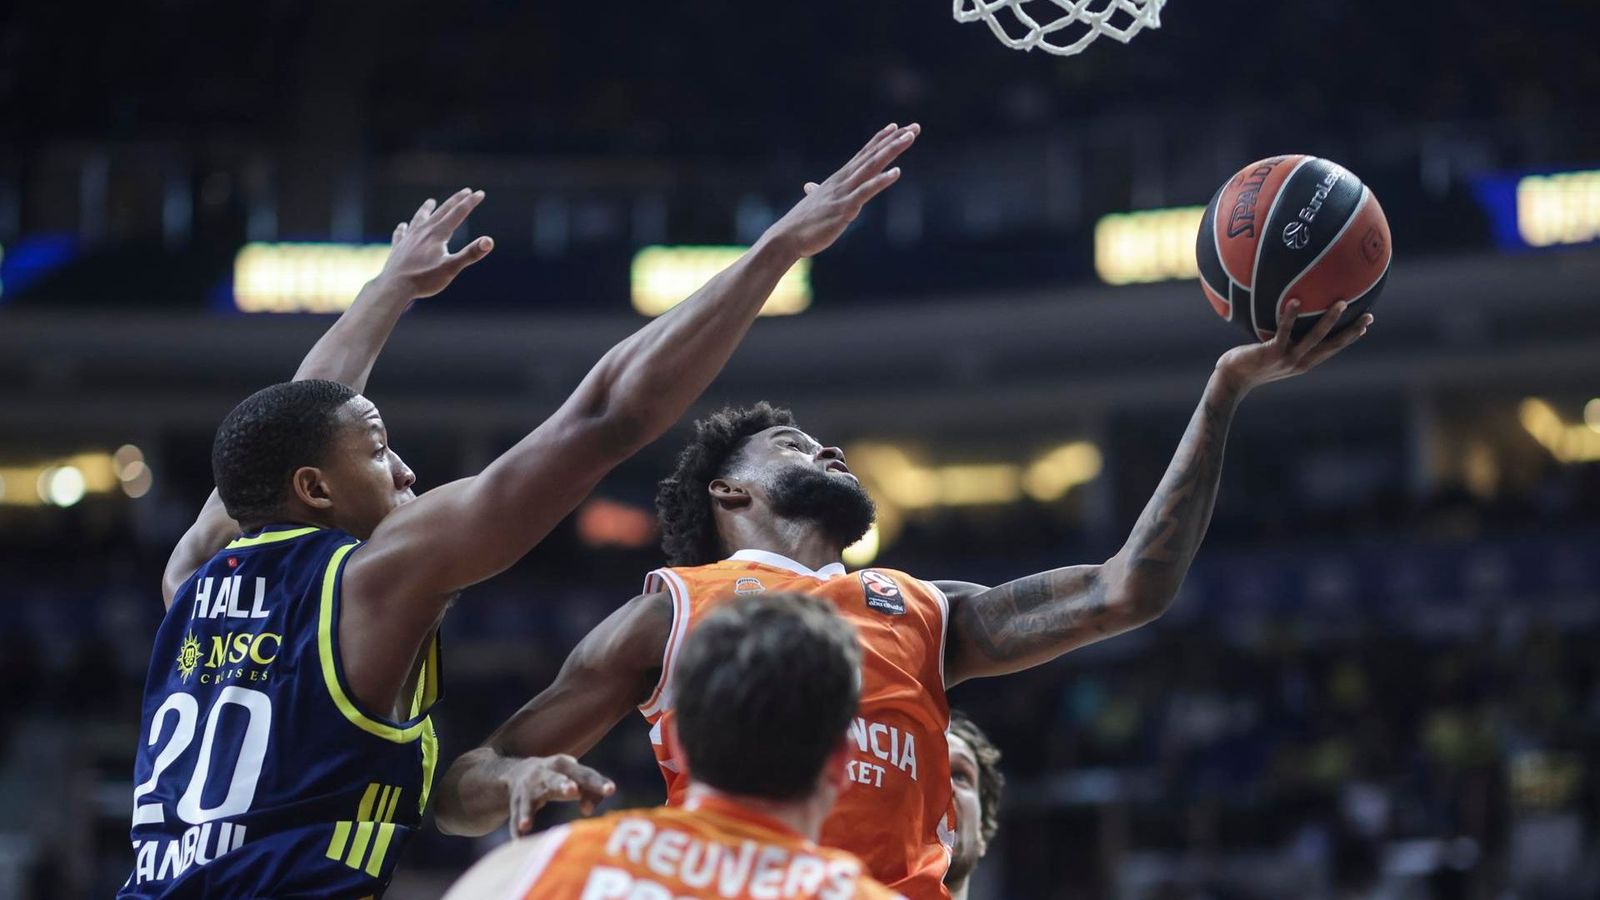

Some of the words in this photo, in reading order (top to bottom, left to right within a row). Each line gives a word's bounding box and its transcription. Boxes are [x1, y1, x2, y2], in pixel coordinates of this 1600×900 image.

[1226, 156, 1284, 238] SPALD
[191, 575, 270, 620] HALL
[204, 632, 283, 668] MSC
[131, 685, 273, 828] 20
[847, 716, 918, 781] NCIA
[606, 817, 861, 900] REUVERS
